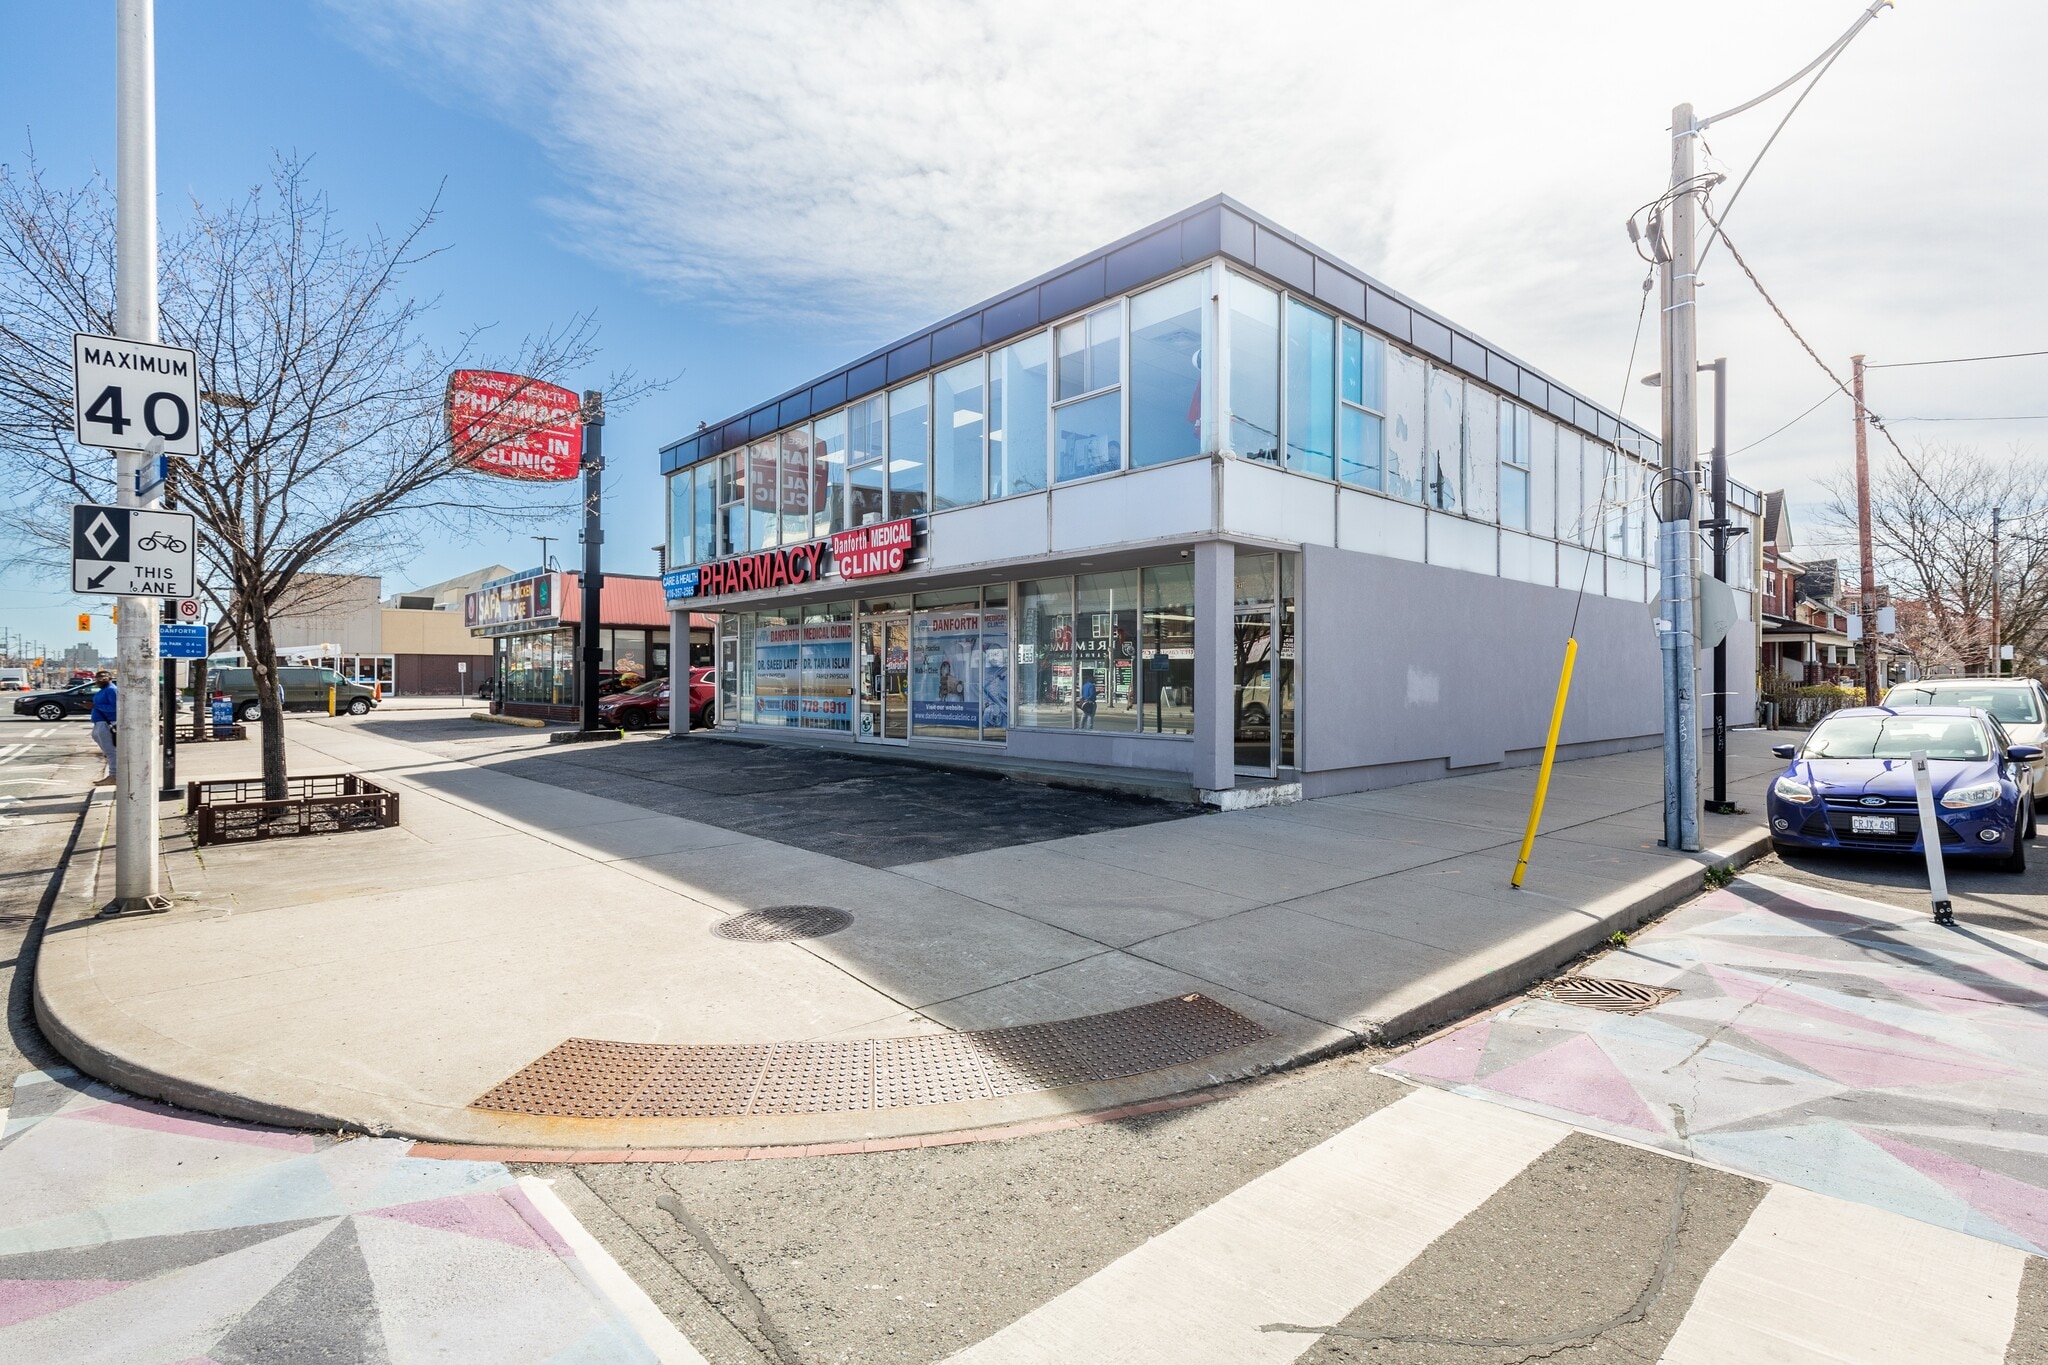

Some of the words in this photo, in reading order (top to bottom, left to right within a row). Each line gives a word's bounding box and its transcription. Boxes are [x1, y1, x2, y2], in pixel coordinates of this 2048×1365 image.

[84, 347, 188, 377] MAXIMUM
[470, 376, 506, 391] CARE
[509, 383, 517, 392] &
[521, 386, 567, 404] HEALTH
[84, 385, 190, 442] 40
[454, 390, 579, 430] PHARMACY
[548, 438, 569, 456] IN
[481, 447, 556, 473] CLINIC
[834, 531, 867, 555] Danforth
[871, 522, 911, 548] MEDICAL
[701, 542, 826, 598] PHARMACY
[841, 547, 901, 576] CLINIC
[134, 566, 173, 579] THIS
[663, 576, 675, 587] CARE
[676, 575, 680, 585] &
[680, 572, 699, 584] HEALTH
[130, 581, 177, 594] LANE
[932, 617, 978, 631] DANFORTH
[770, 629, 800, 642] DANFORTH
[803, 626, 830, 641] MEDICAL
[831, 625, 851, 639] CLINIC
[783, 659, 798, 670] LATIF
[832, 657, 850, 669] ISLAM
[781, 699, 799, 712] (416)
[803, 700, 847, 715] 778-0911
